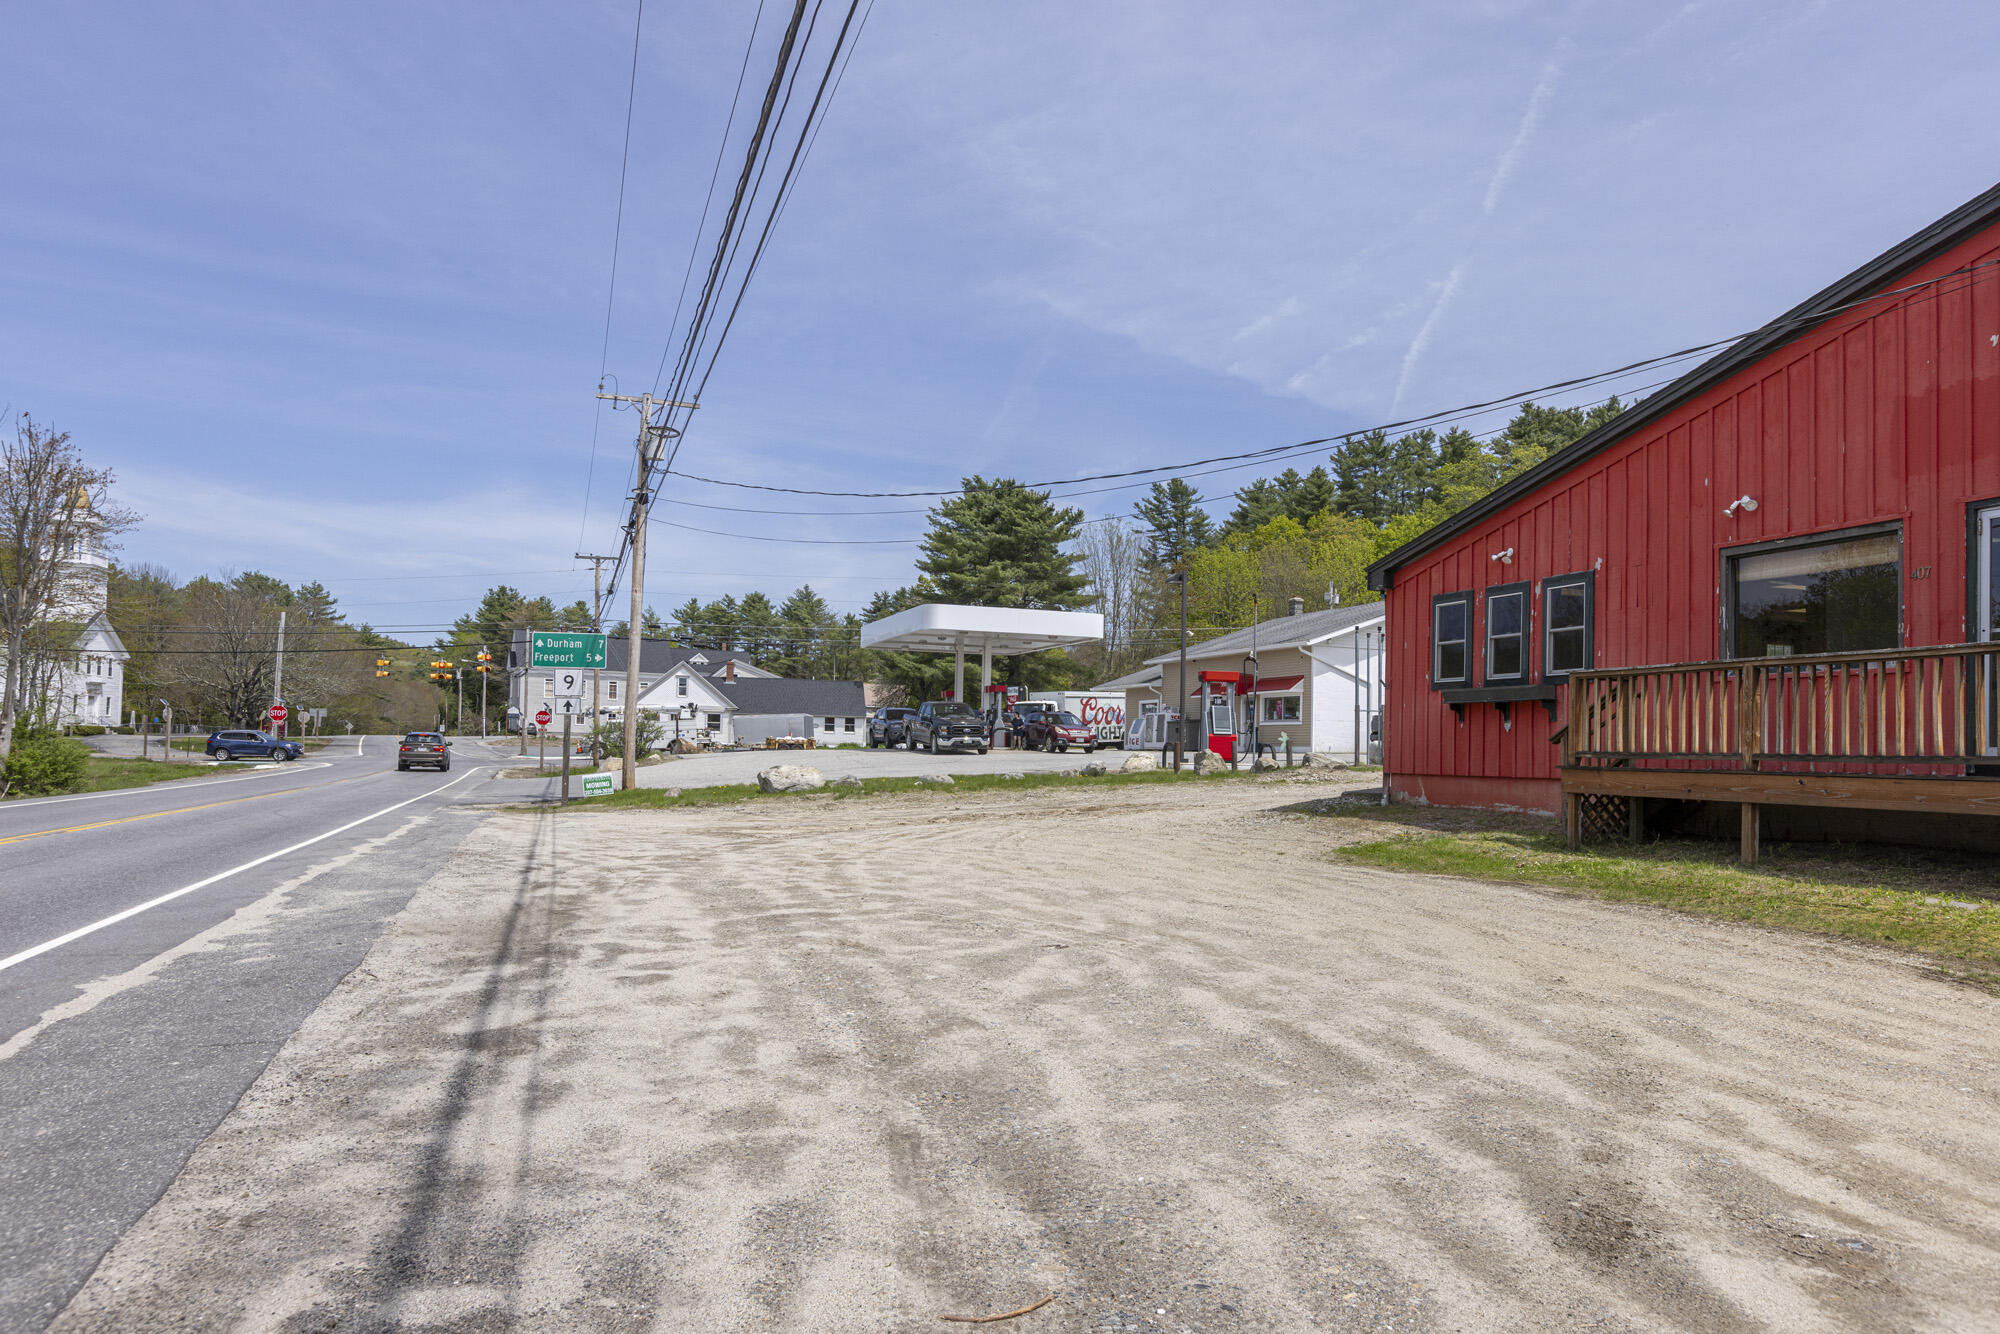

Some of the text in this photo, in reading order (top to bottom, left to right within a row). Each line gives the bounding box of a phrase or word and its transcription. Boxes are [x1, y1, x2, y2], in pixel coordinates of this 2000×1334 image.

[1911, 566, 1931, 579] 407
[547, 639, 604, 649] Durham 7
[534, 652, 592, 664] Freeport 5
[563, 675, 574, 690] 9
[1129, 738, 1140, 746] ICE
[586, 781, 610, 789] MOWING
